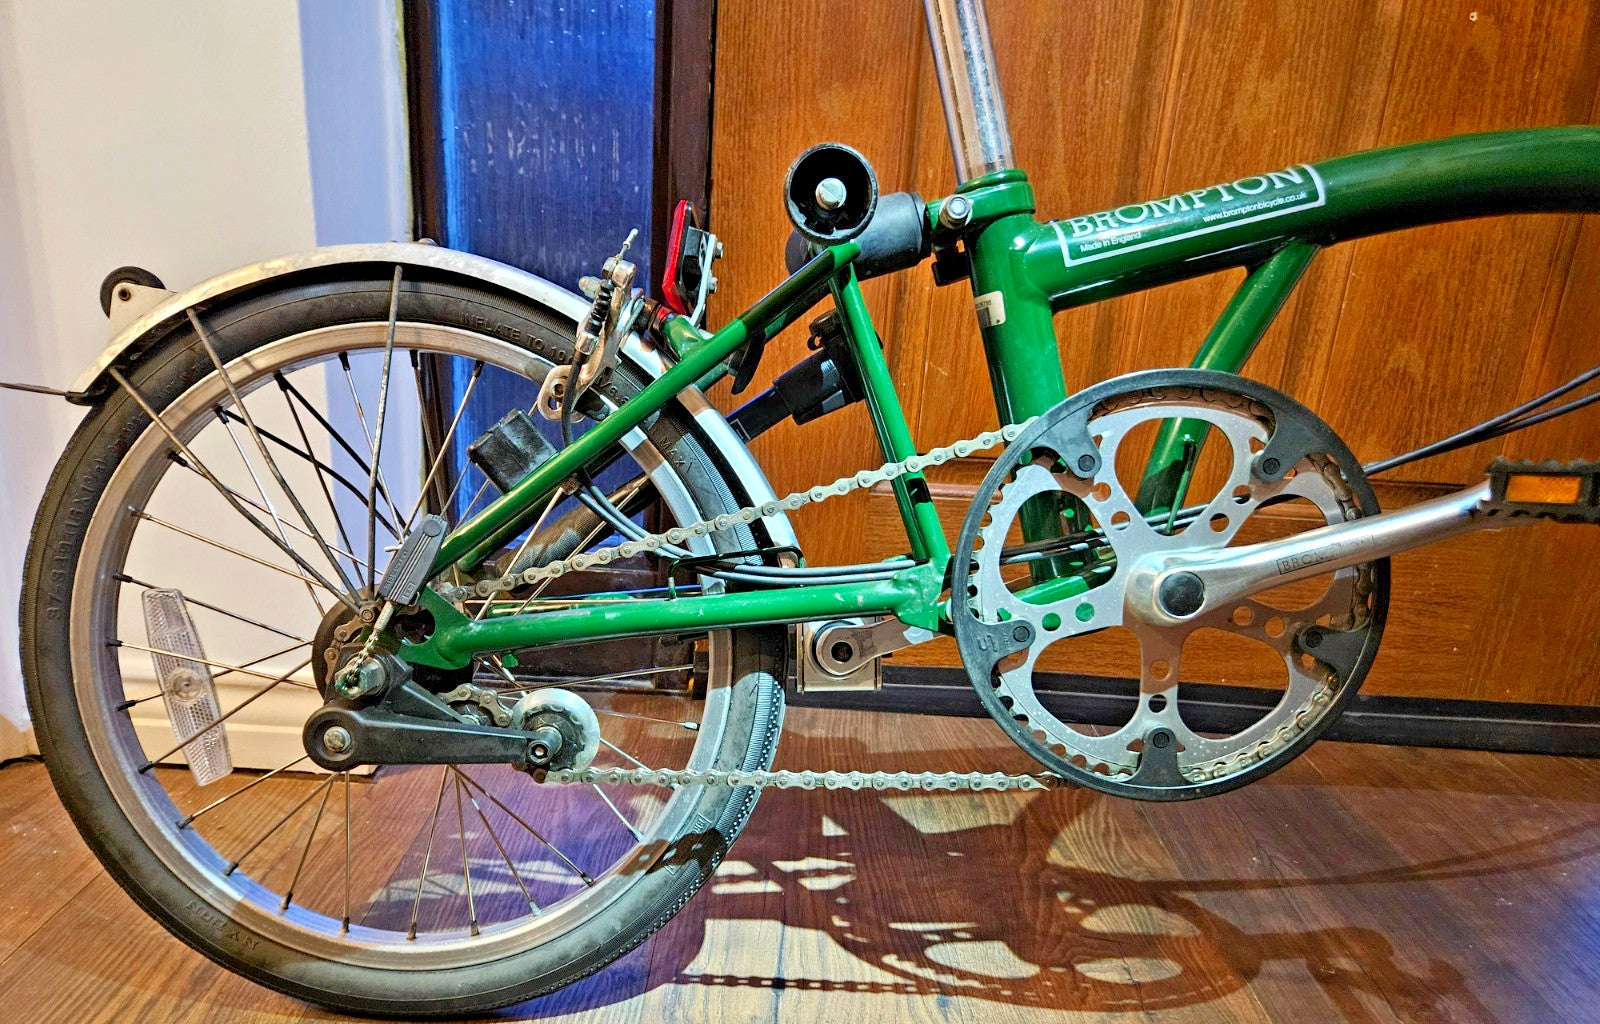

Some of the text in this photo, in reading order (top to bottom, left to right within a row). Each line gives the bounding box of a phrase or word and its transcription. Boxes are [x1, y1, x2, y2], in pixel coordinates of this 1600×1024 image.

[1070, 167, 1307, 238] BROMPTON
[1202, 191, 1308, 223] www.bromptonbicycle.co.uk
[1080, 232, 1142, 252] Made in England
